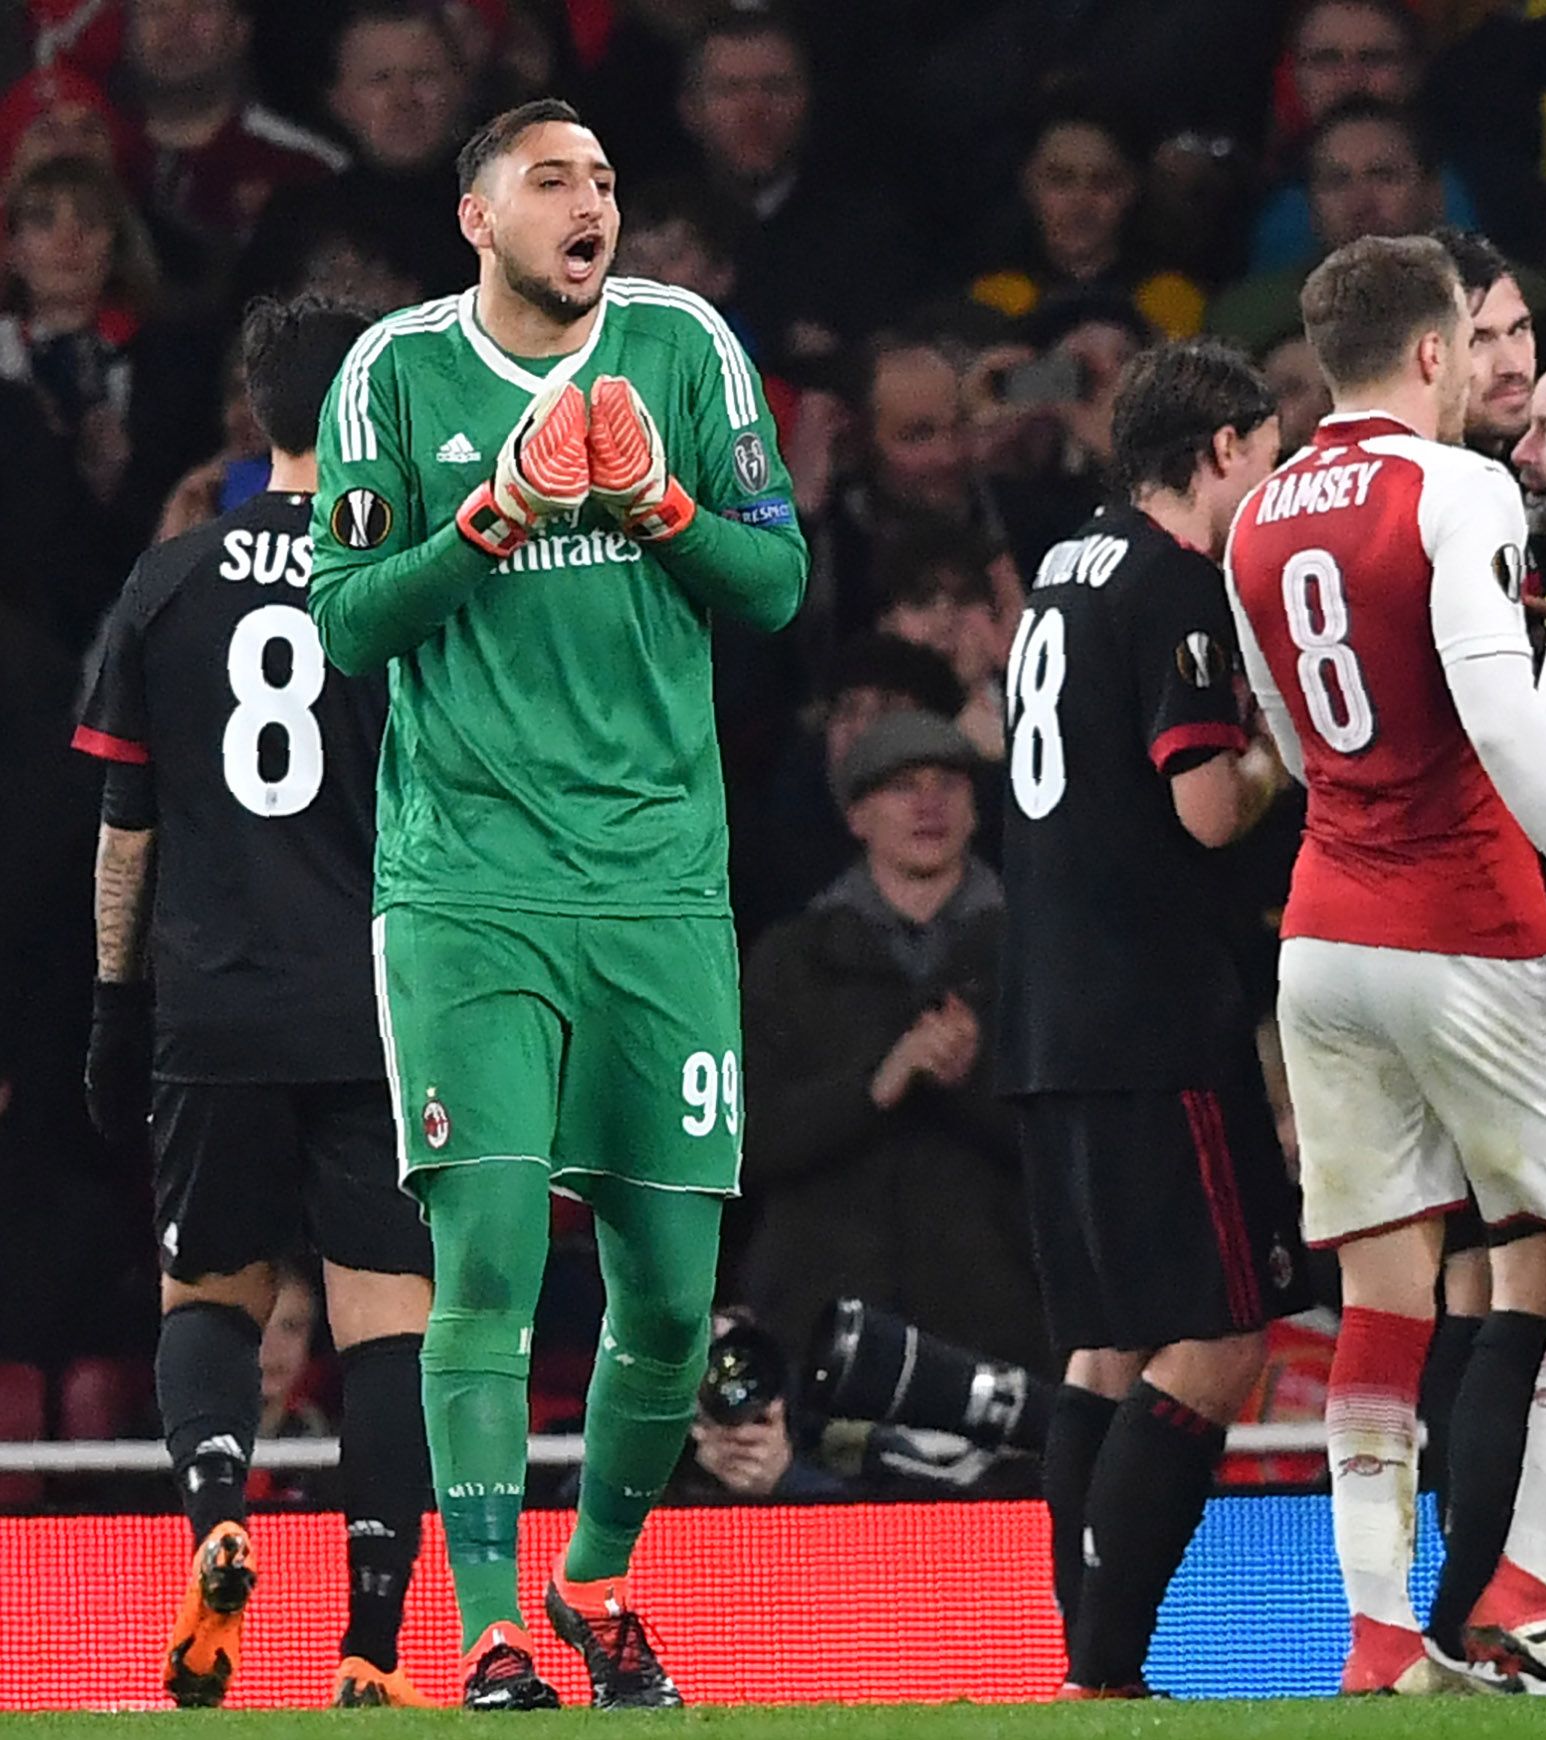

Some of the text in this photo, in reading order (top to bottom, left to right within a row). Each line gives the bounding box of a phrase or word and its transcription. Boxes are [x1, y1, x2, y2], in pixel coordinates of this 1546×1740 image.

[1256, 461, 1381, 525] RAMSEY
[220, 529, 315, 588] SUS
[490, 527, 642, 575] mirates
[1282, 549, 1375, 753] 8
[223, 604, 324, 817] 8
[1007, 607, 1067, 820] 18
[682, 1049, 739, 1137] 99
